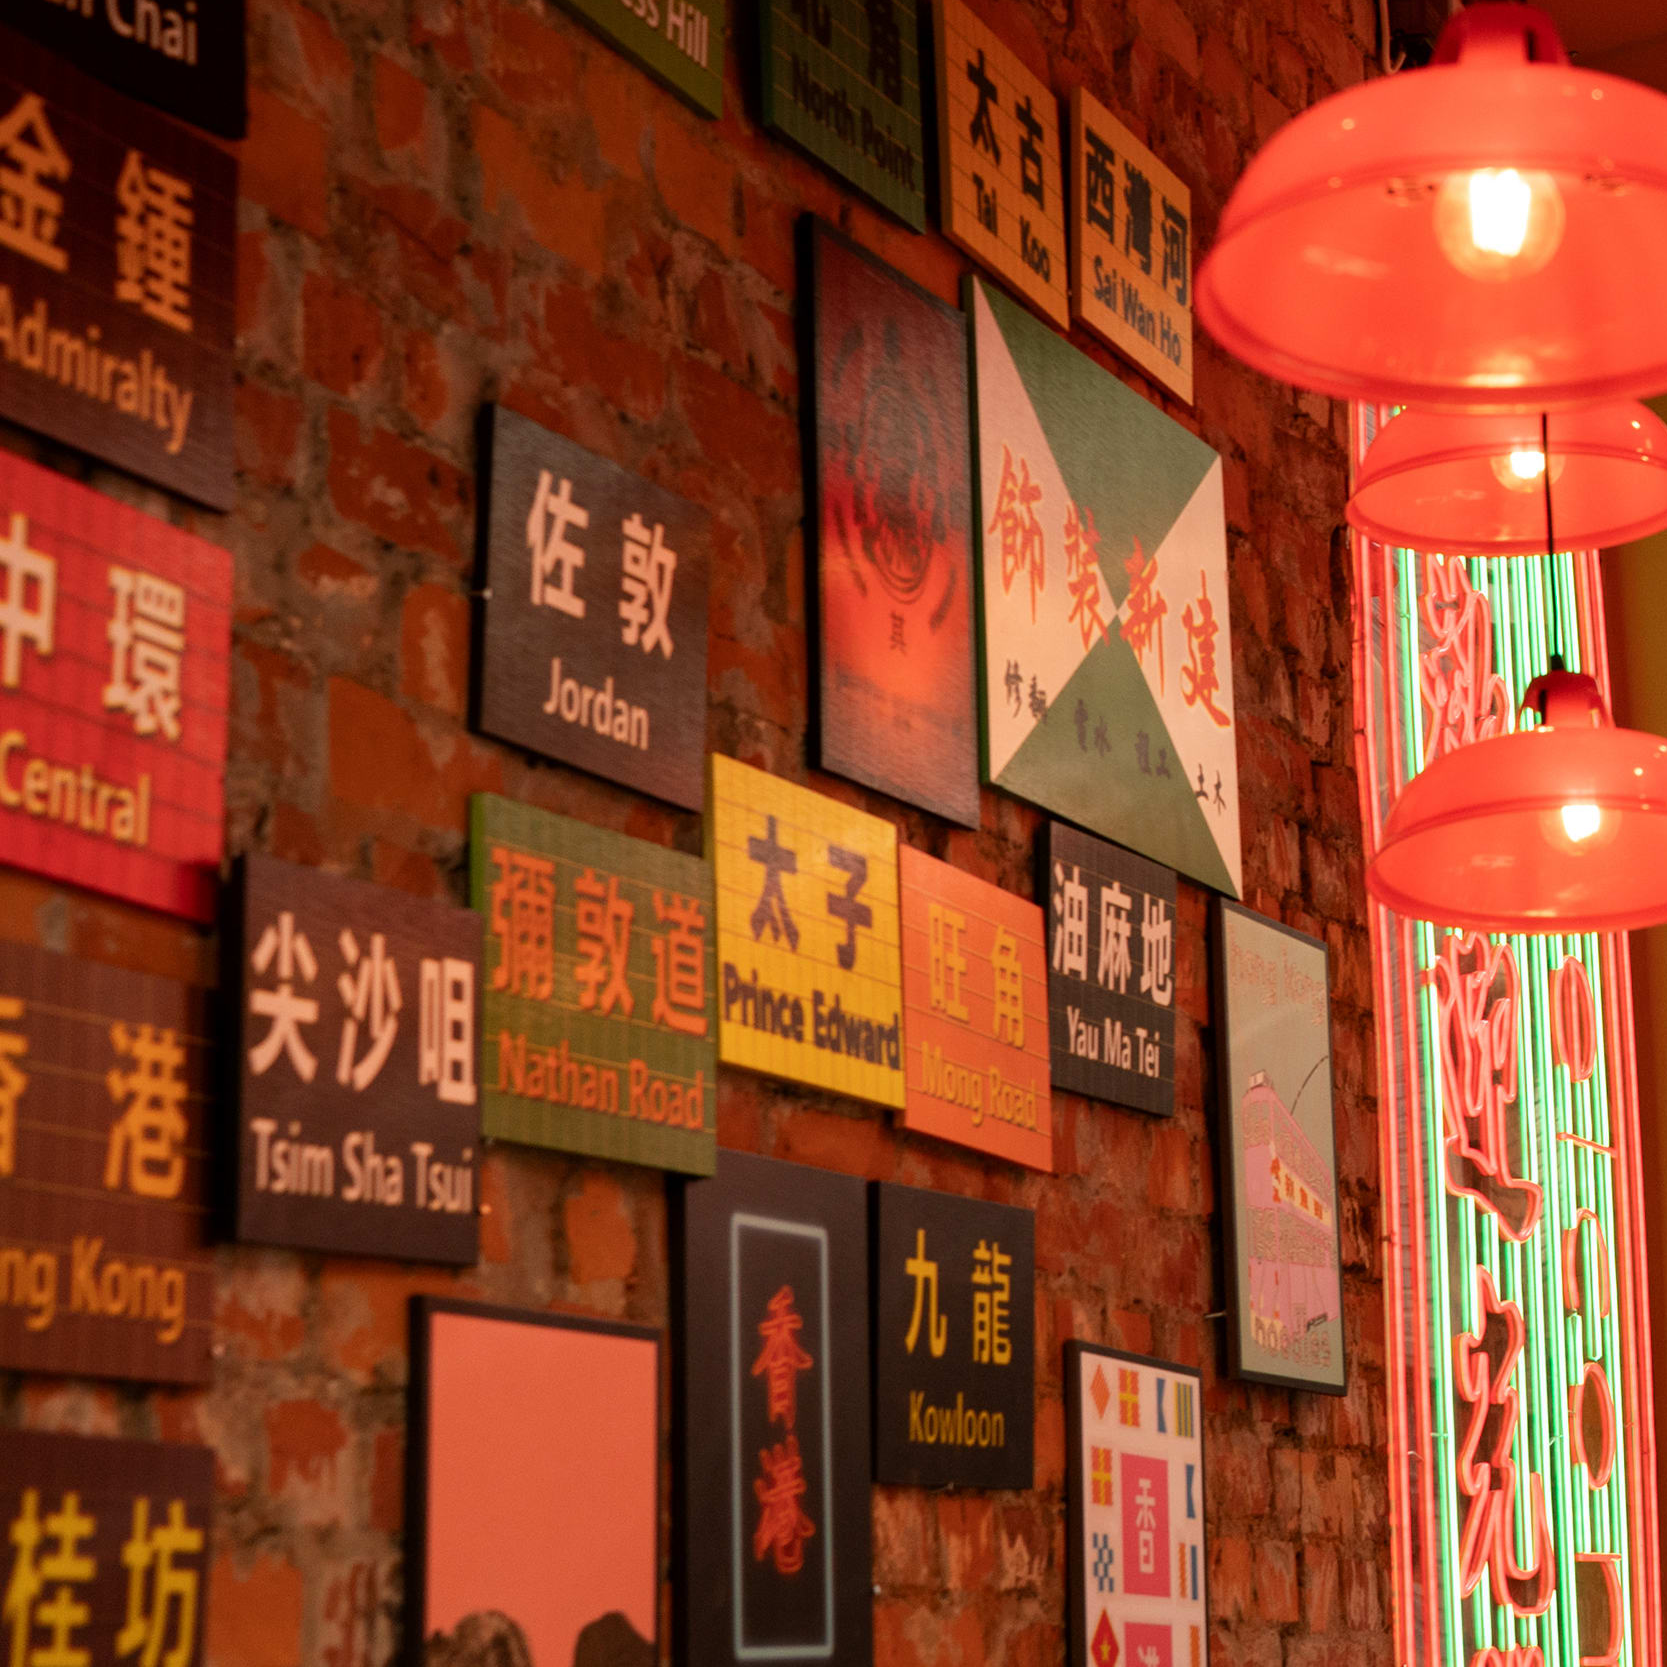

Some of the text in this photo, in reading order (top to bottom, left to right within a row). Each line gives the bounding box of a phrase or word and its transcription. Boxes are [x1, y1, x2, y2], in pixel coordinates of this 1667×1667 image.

[791, 51, 918, 191] North Point
[966, 46, 1045, 214] 太古
[970, 172, 1052, 284] Tai Koo
[1084, 125, 1190, 308] 西灣河
[0, 284, 194, 456] Admiralty
[1092, 255, 1183, 366] Sai Wan Ho
[0, 511, 187, 742] 中環
[526, 468, 679, 661] 佐敦
[543, 656, 650, 753] Jordan
[0, 729, 151, 848] Central
[490, 846, 707, 1038] 彌敦道
[747, 813, 873, 972] 太子
[1049, 862, 1173, 1008] 油麻地
[248, 910, 479, 1107] 尖沙咀
[723, 960, 902, 1073] Prince Edward
[925, 900, 1028, 1053] 旺角
[1066, 1004, 1161, 1080] Yau Ma Tei
[500, 1030, 706, 1132] Nathan Road
[921, 1040, 983, 1128] Mong
[250, 1117, 474, 1216] Tsim Sha Tsui
[70, 1235, 186, 1345] Kong
[903, 1227, 1013, 1368] 九龍
[751, 1285, 815, 1576] 香港
[908, 1390, 1005, 1449] Kowloon
